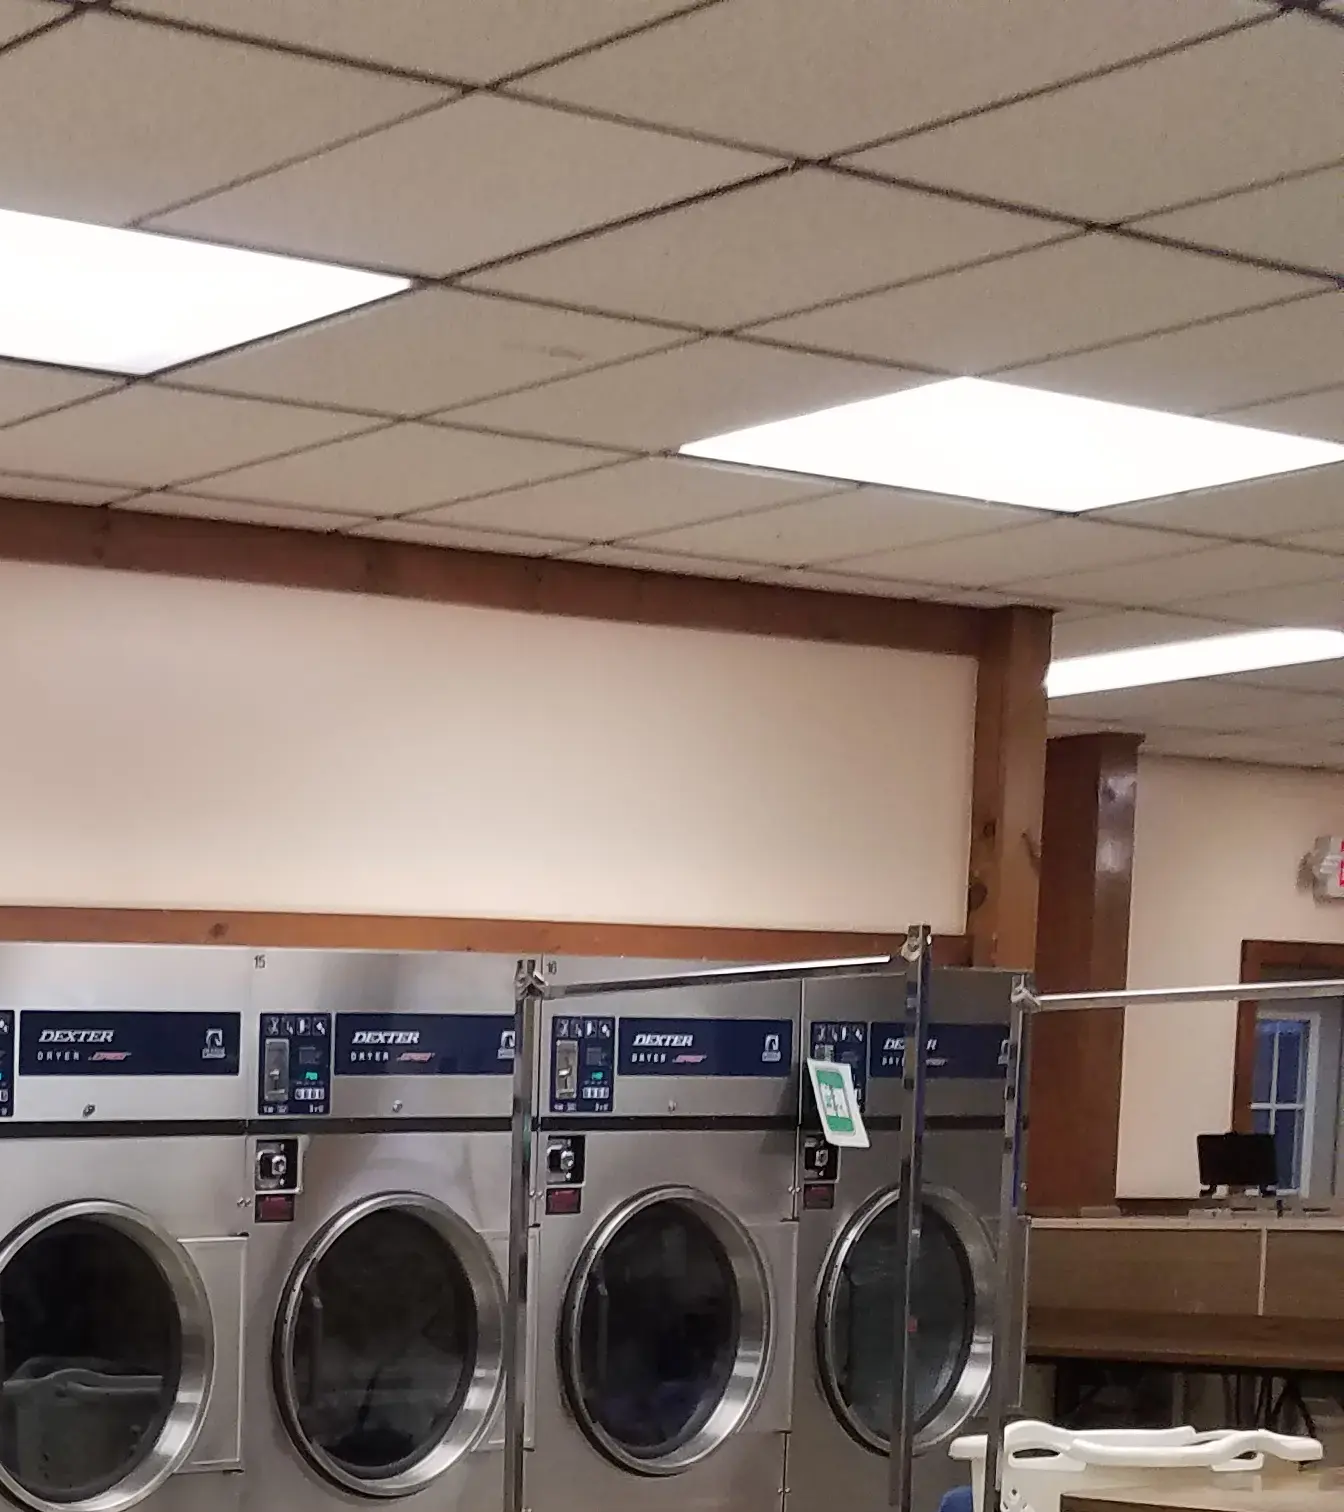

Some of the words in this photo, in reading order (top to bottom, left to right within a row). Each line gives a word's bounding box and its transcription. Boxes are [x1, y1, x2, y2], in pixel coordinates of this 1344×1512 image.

[254, 955, 266, 970] 15
[38, 1029, 114, 1043] DEXTER
[351, 1031, 420, 1044] DEXTER
[632, 1034, 693, 1047] DEXTER
[883, 1038, 937, 1051] DER
